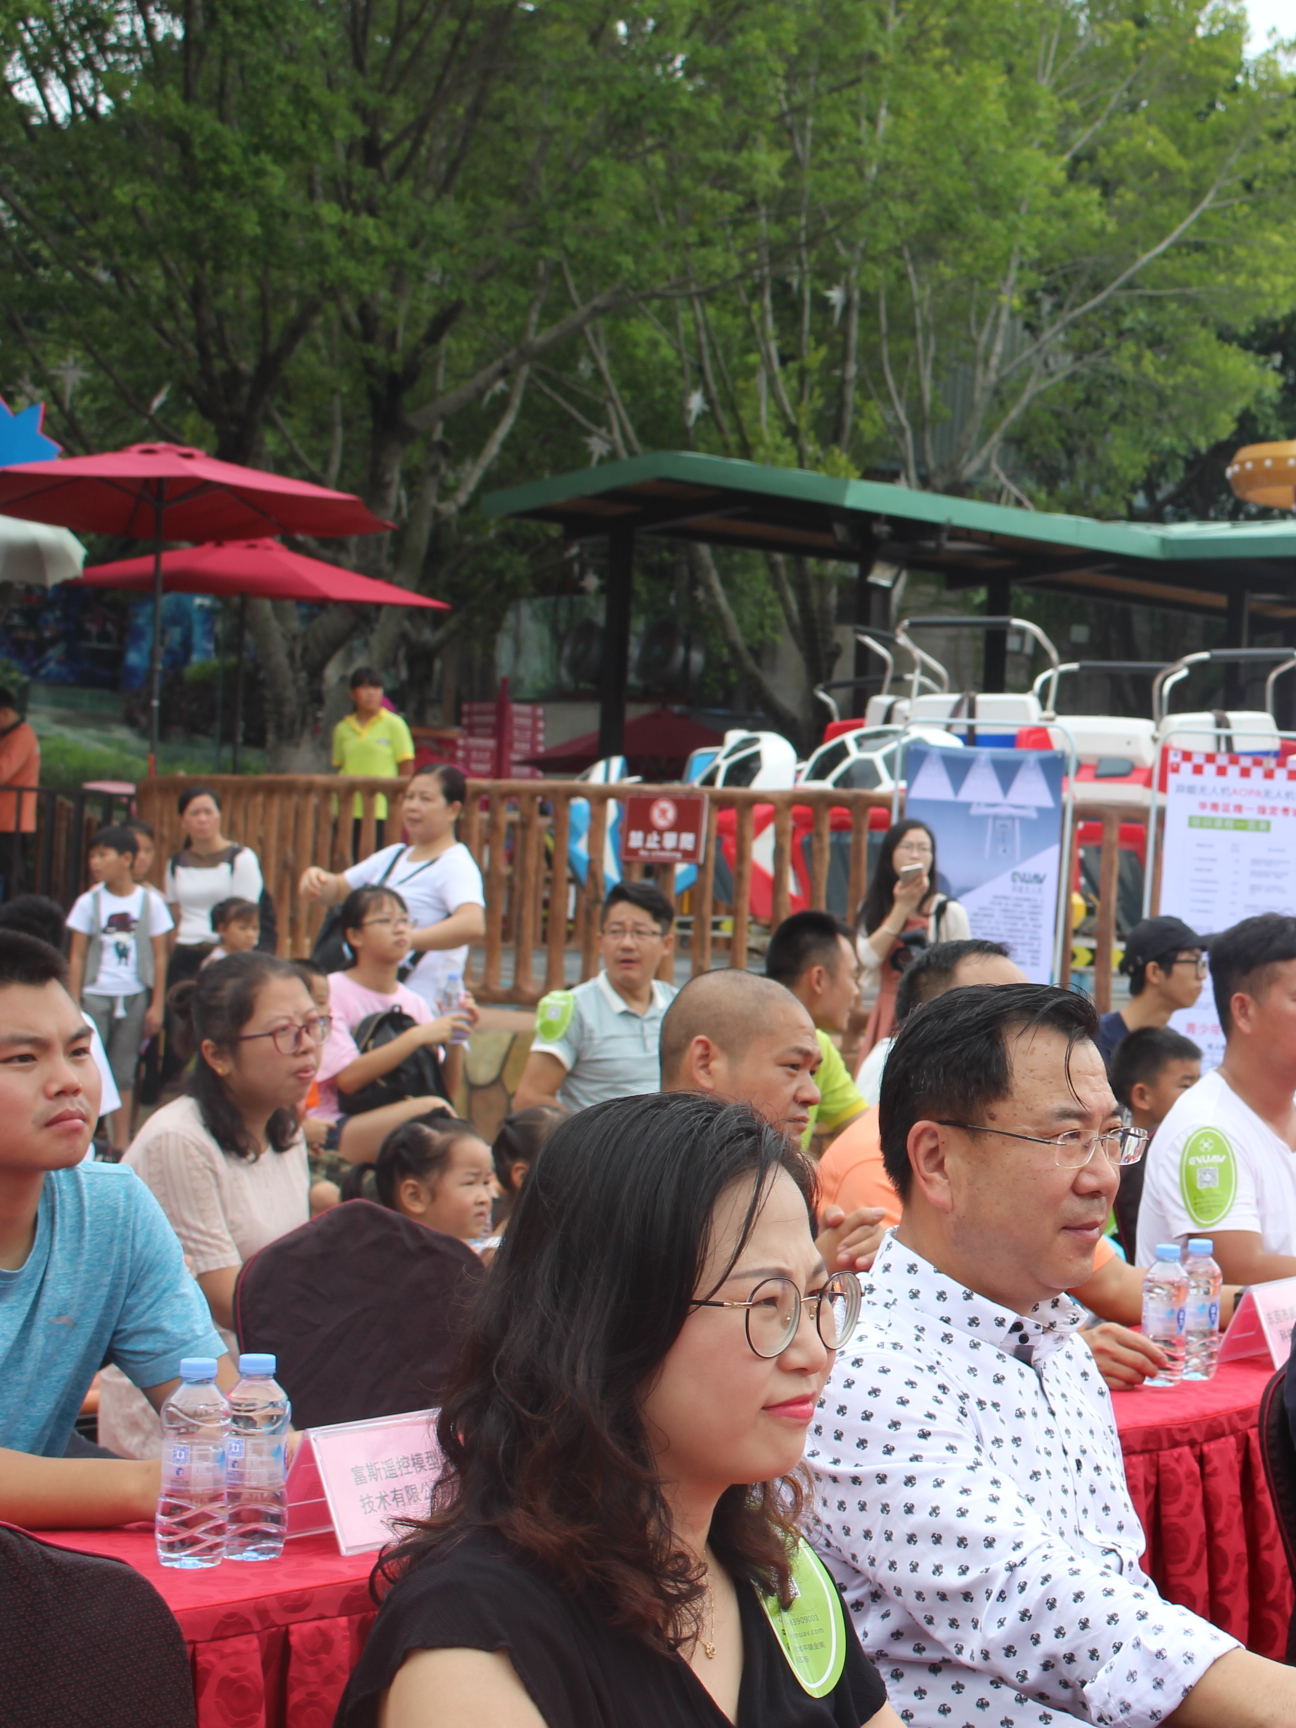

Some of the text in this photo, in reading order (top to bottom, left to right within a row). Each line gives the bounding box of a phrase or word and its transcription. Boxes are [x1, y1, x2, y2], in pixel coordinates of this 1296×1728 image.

[360, 1482, 432, 1514] 技术有限公
